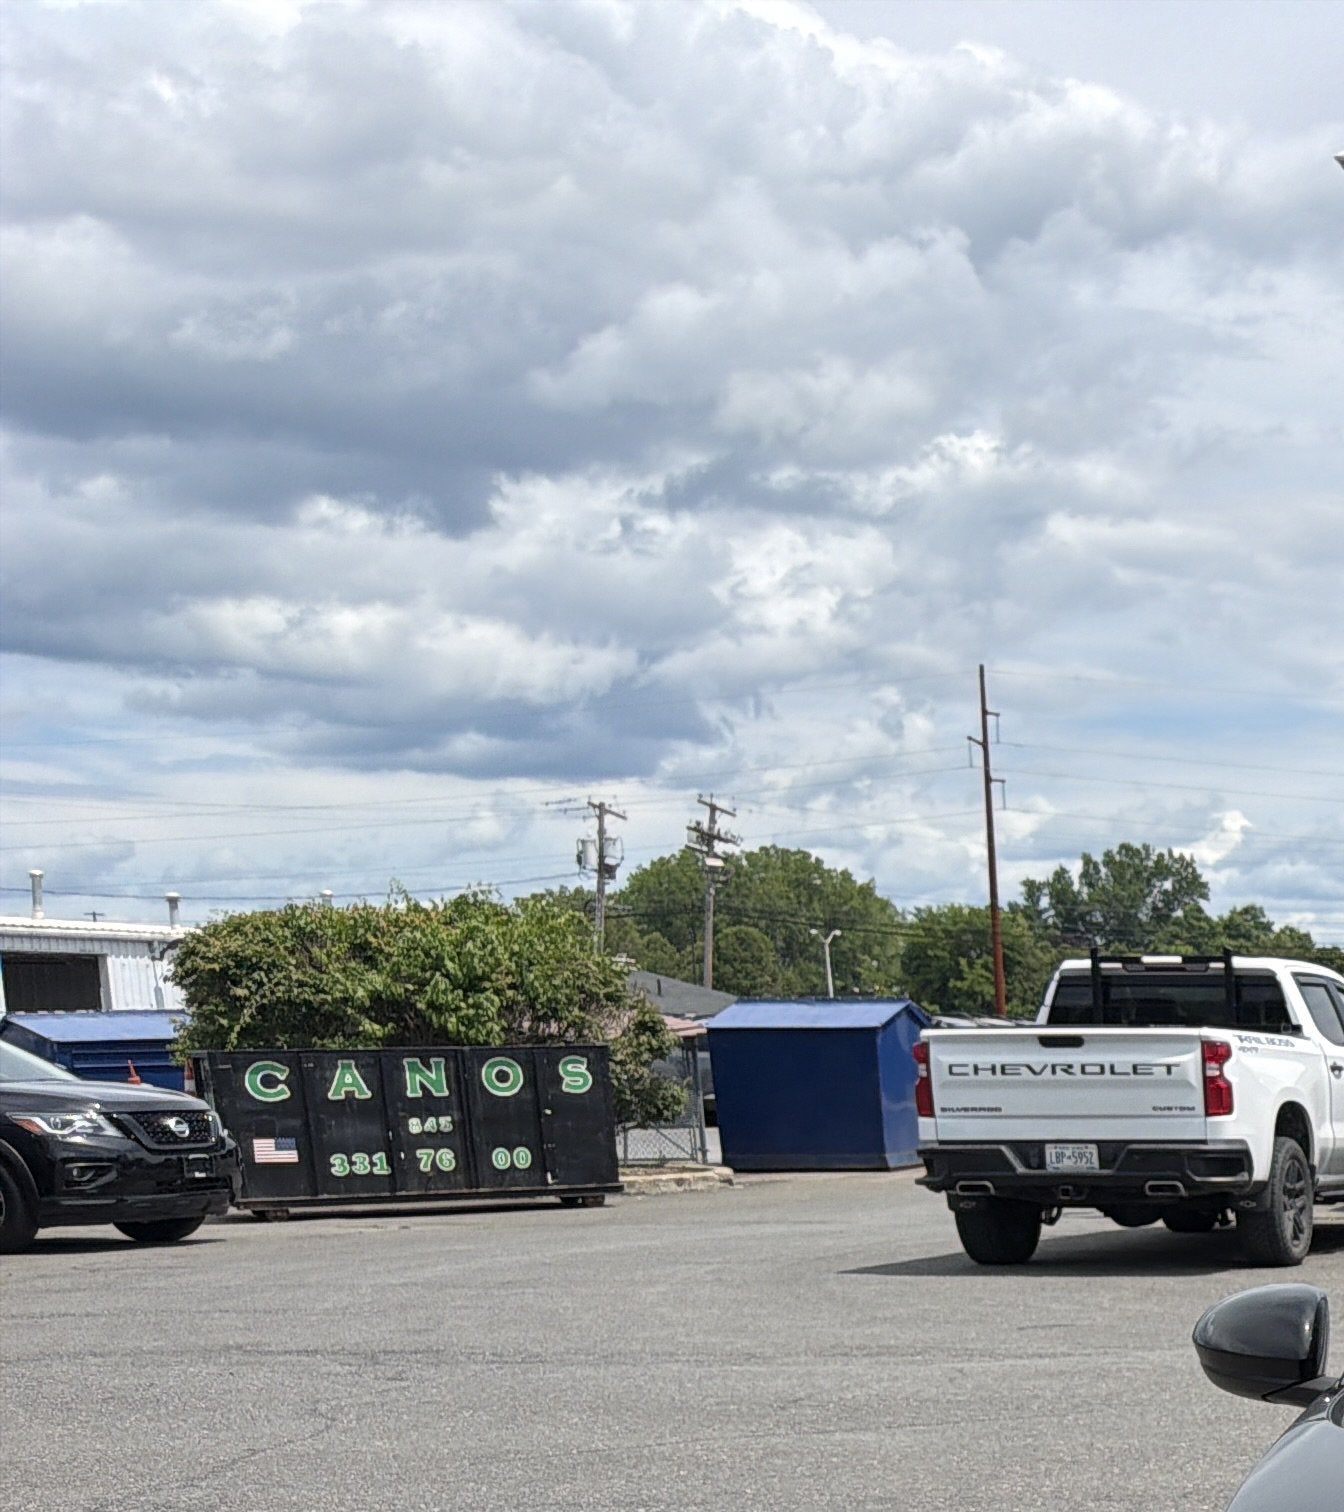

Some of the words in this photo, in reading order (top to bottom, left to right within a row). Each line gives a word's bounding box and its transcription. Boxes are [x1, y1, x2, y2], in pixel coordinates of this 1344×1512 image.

[244, 1054, 593, 1102] CANOS
[948, 1063, 1181, 1077] CHEVROLET
[330, 1152, 392, 1178] 331
